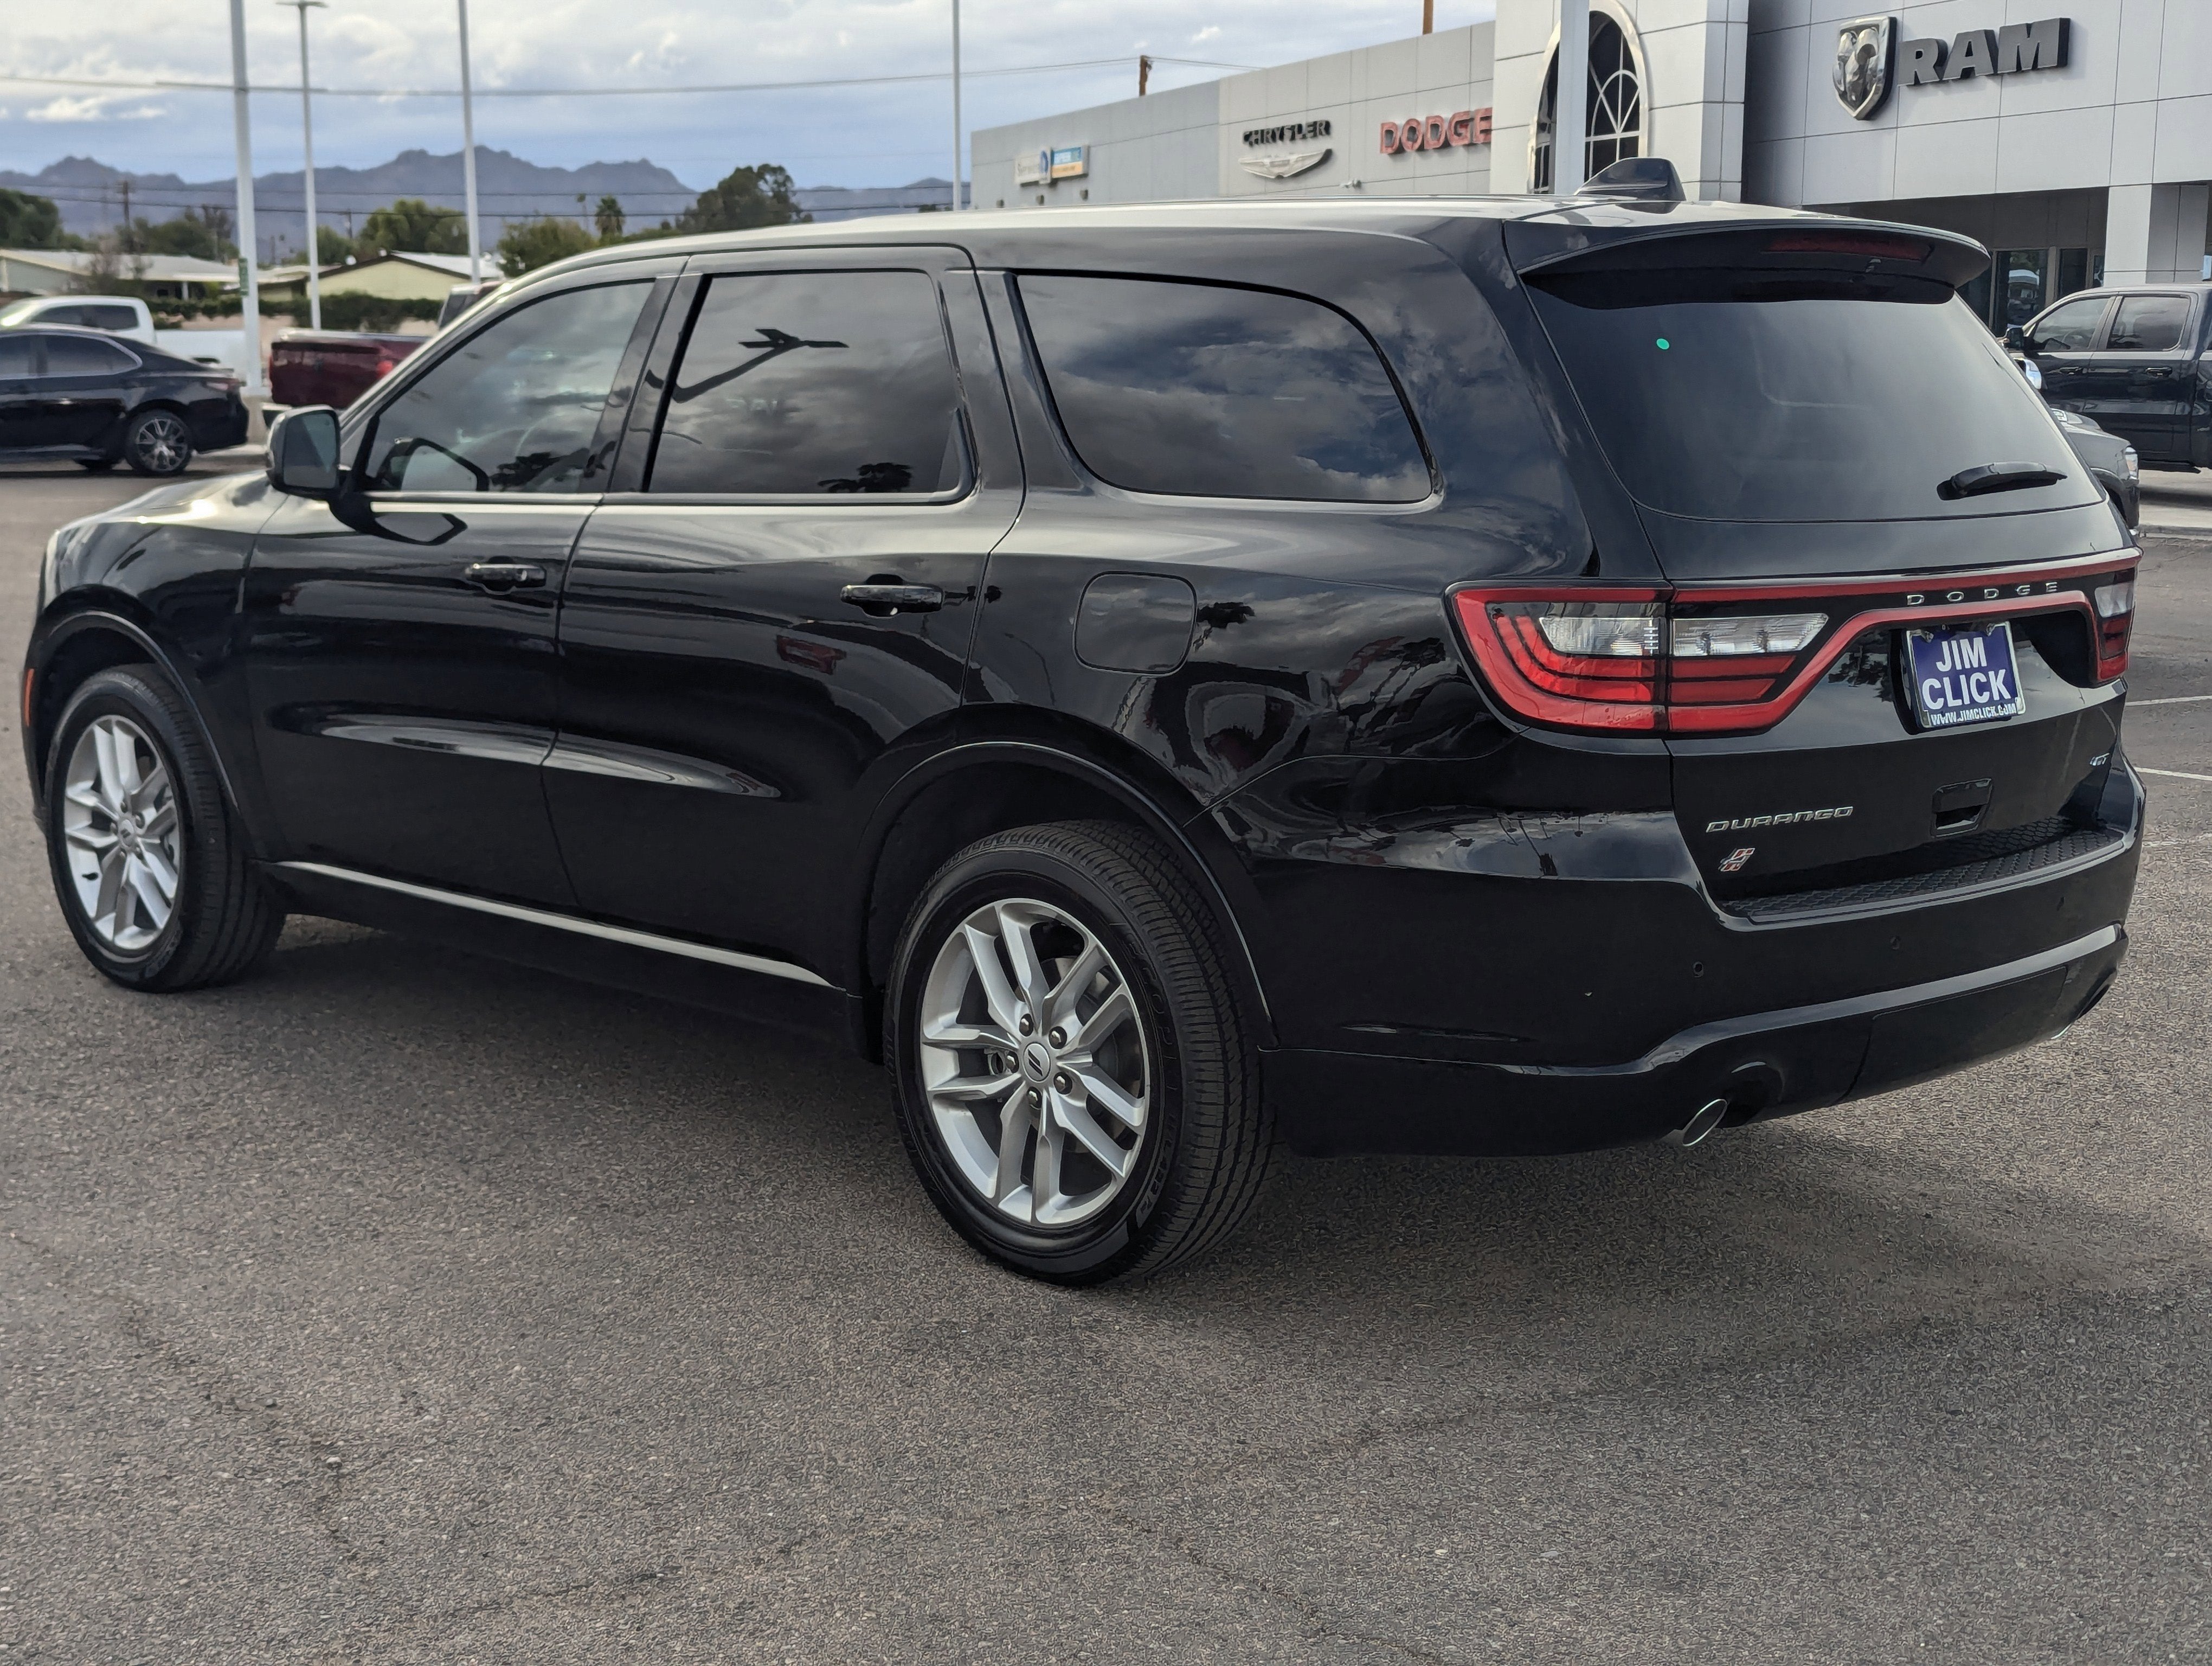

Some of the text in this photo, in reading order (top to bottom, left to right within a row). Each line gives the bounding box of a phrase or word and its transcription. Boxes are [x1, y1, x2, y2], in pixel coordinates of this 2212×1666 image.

[1898, 18, 2070, 85] RAM
[1243, 120, 1330, 147] CHRYSLER
[1380, 107, 1493, 153] DODGE
[1907, 582, 2058, 605] DODGE
[1936, 637, 1987, 672] JIM
[1922, 669, 2011, 709] CLICK
[1706, 806, 1853, 832] DURANGO
